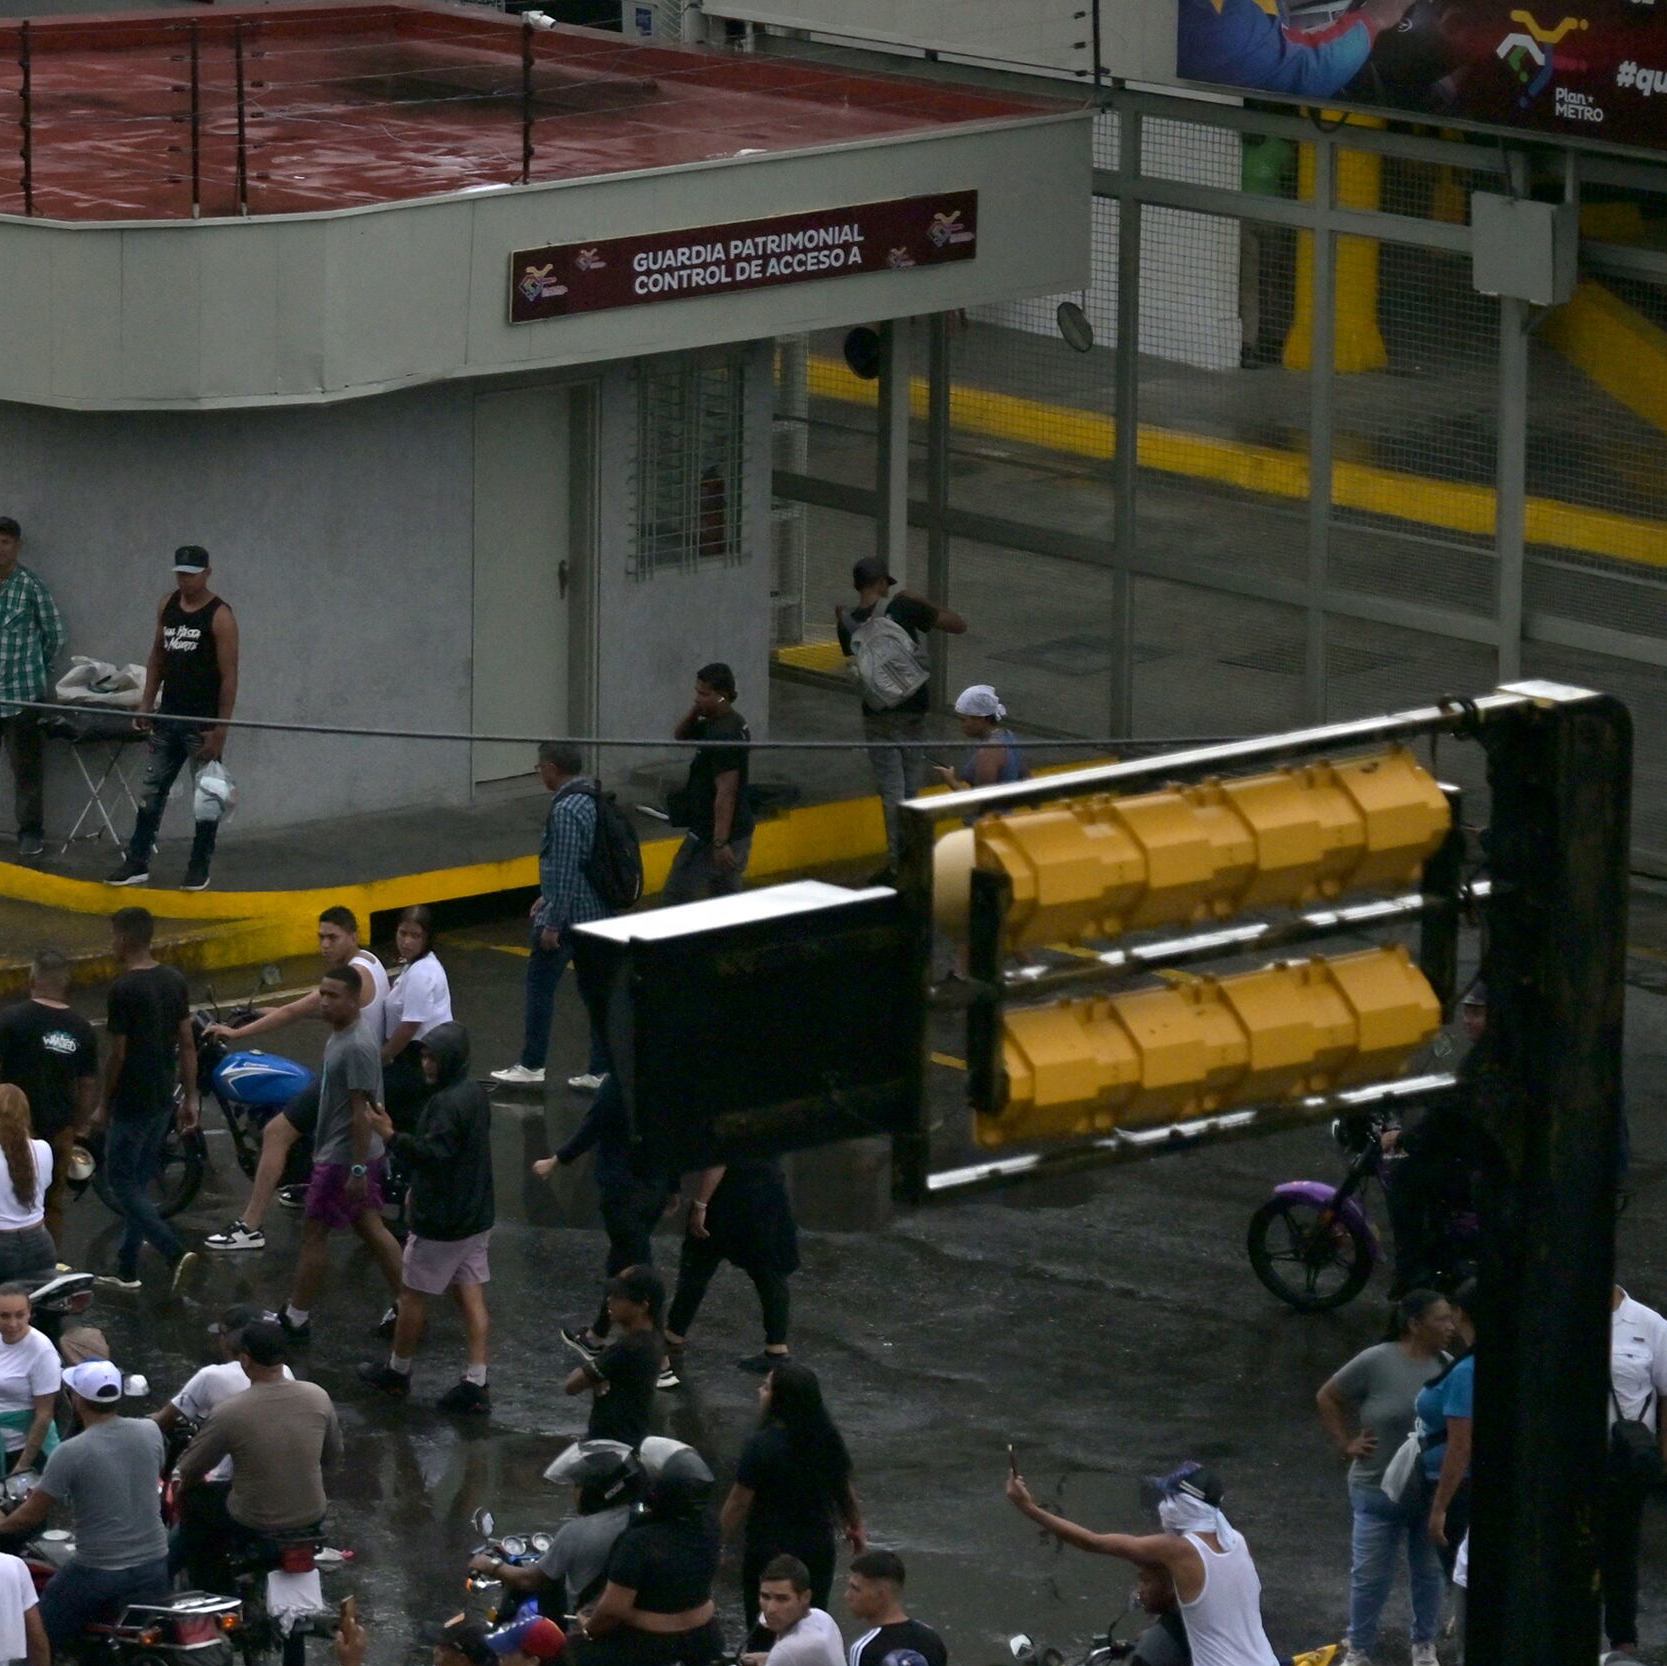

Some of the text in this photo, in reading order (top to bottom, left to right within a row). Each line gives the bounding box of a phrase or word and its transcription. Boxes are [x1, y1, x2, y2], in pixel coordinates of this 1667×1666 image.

[1555, 87, 1586, 105] Plan
[1555, 103, 1604, 122] METRO
[633, 223, 865, 272] GUARDIA PATRIMONIAL
[634, 247, 862, 295] CONTROL DE ACCESO A
